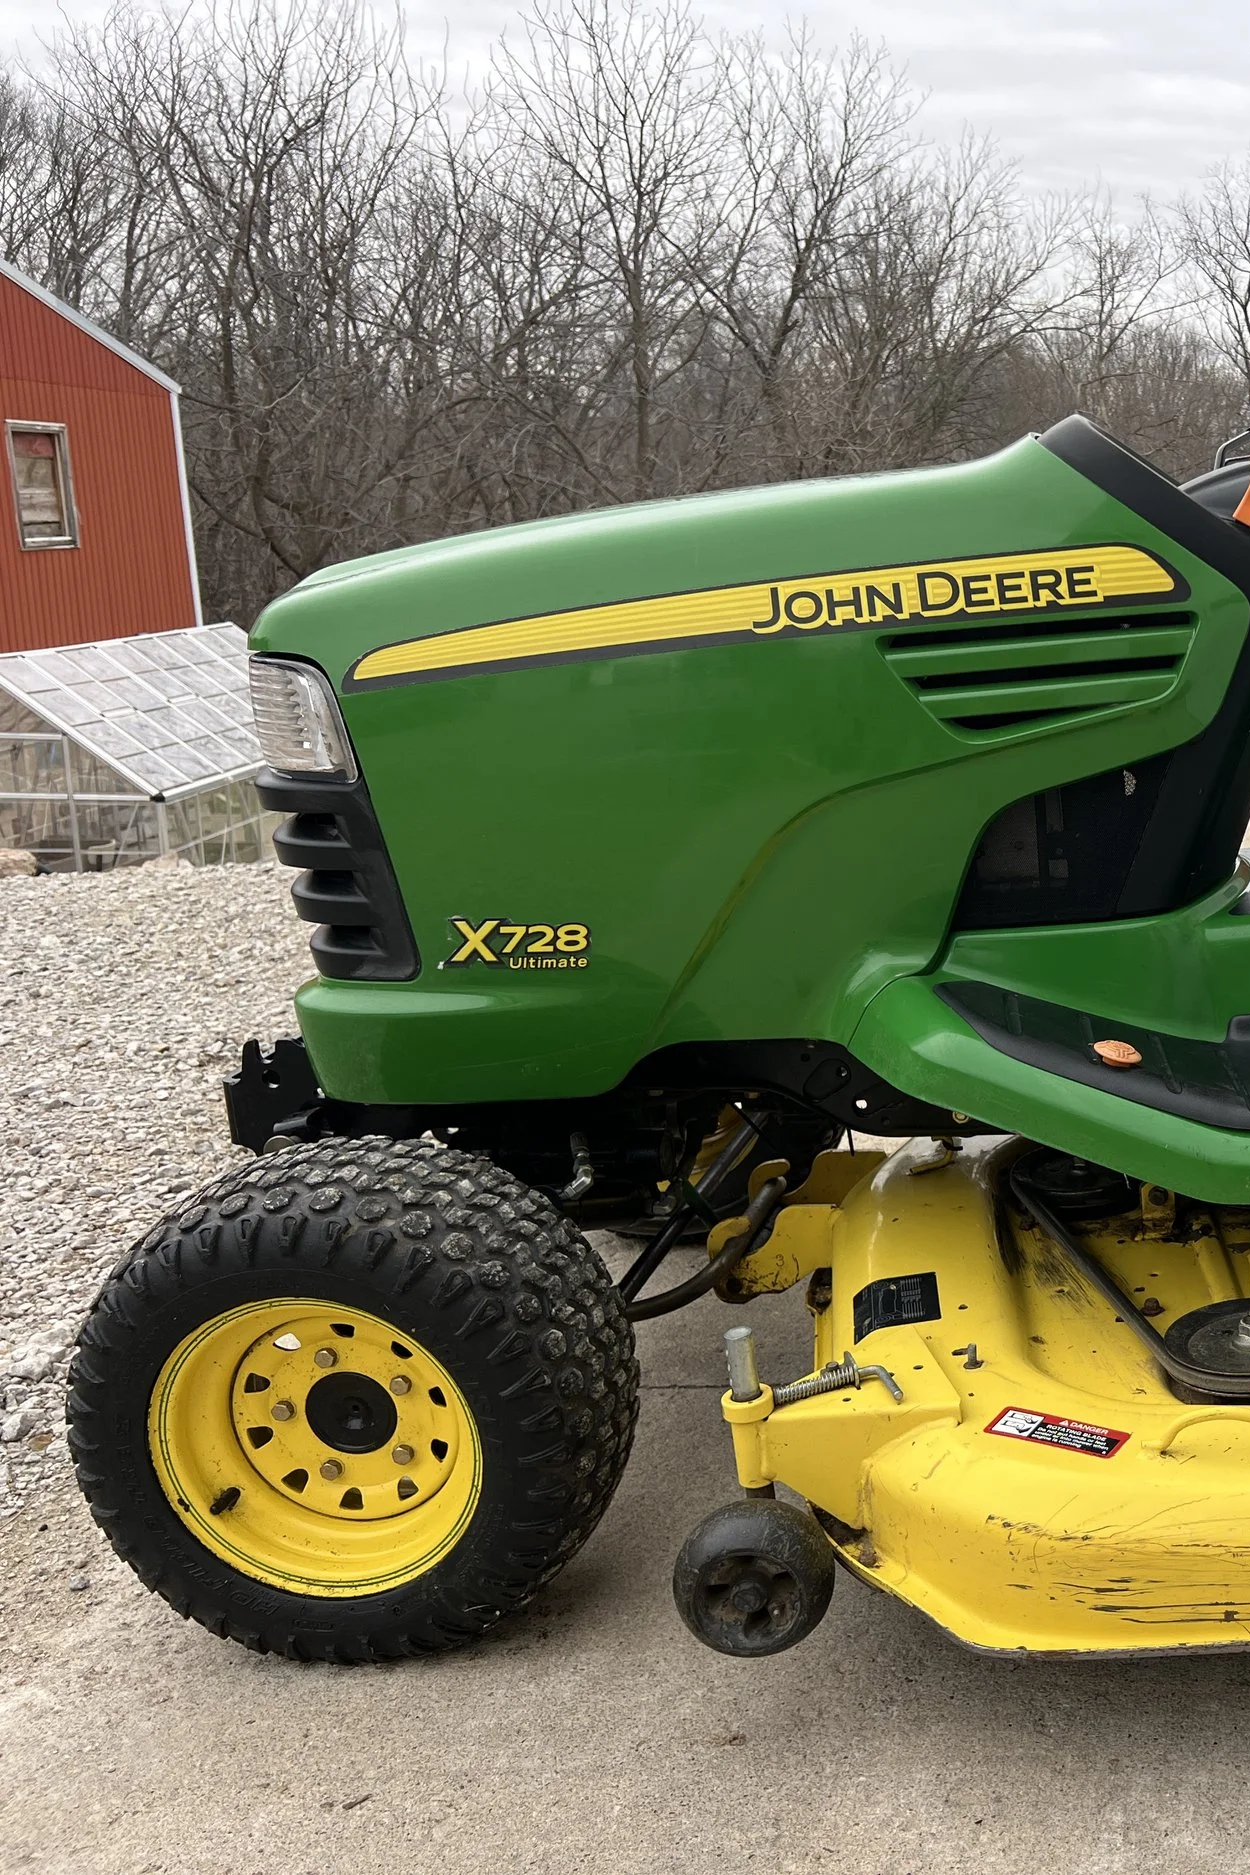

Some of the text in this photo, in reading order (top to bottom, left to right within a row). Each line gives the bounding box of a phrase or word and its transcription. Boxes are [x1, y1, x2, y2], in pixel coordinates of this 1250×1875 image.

[752, 565, 1098, 629] JOHN DEERE
[450, 920, 588, 962] X728
[509, 955, 588, 970] Ultimate
[1046, 1424, 1107, 1441] ROTATING BLADE
[1070, 1421, 1109, 1435] DANGER
